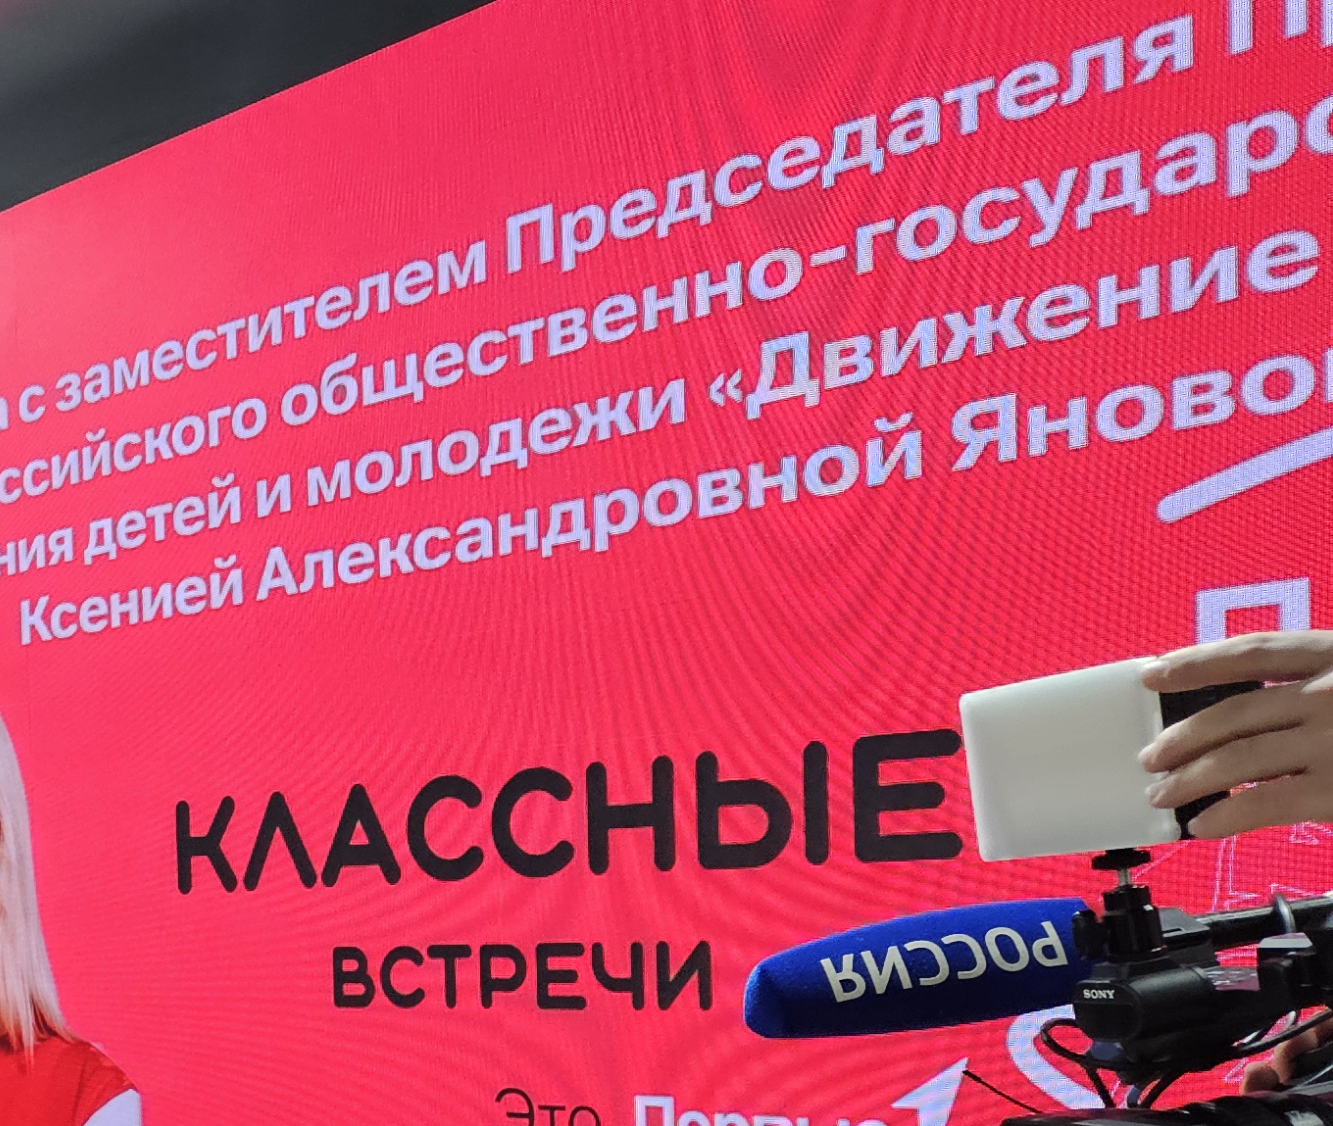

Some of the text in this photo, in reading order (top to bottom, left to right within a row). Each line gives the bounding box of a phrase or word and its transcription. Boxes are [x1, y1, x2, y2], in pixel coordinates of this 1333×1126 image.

[18, 384, 46, 423] с
[55, 240, 487, 412] заместителем
[503, 13, 1194, 274] Председателя
[83, 472, 242, 566] детей
[256, 473, 292, 518] и
[307, 378, 685, 507] молодежи
[709, 230, 1321, 420] «Движение
[19, 347, 1333, 646] Ксенией Александровной Яново
[175, 728, 964, 896] КЛАССНЫЕ
[332, 940, 713, 1011] ВСТРЕЧИ
[819, 920, 1069, 1003] РОССИЯ
[1082, 988, 1116, 1000] SONY
